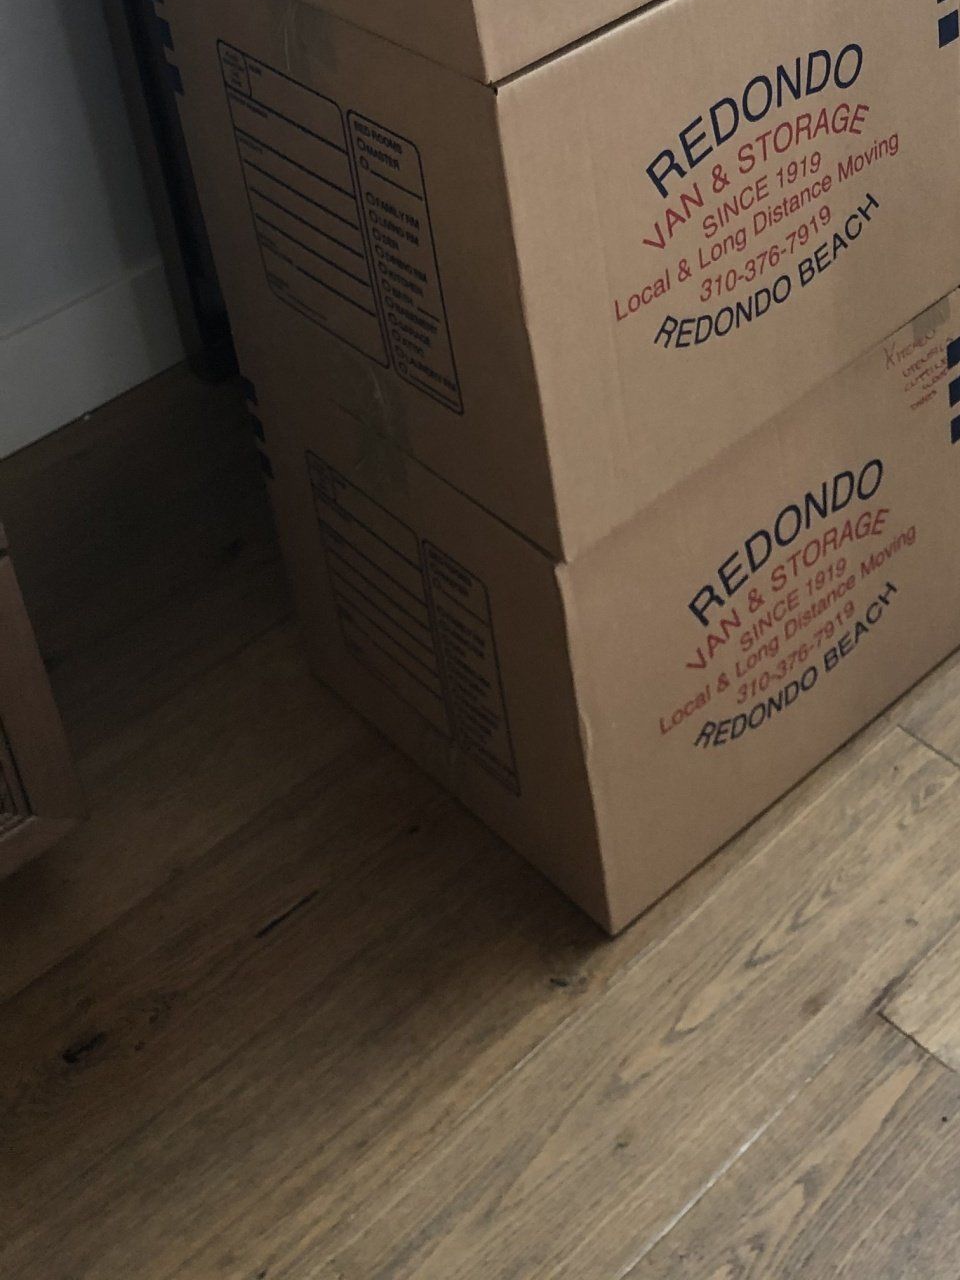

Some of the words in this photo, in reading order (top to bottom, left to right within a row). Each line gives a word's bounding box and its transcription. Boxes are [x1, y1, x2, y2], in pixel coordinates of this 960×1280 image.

[642, 182, 703, 248] VAN
[712, 164, 730, 193] &
[739, 103, 870, 174] STORAGE
[645, 43, 862, 198] REDONDO
[703, 175, 768, 238] SINCE
[777, 152, 820, 187] 1919
[615, 269, 670, 321] Local
[678, 259, 692, 282] &
[699, 228, 746, 269] Long
[754, 175, 831, 235] Distance
[838, 132, 898, 182] Moving
[654, 274, 791, 348] REDONDO
[799, 192, 879, 286] BEACH
[700, 206, 830, 302] 310-376-7919
[685, 607, 739, 668] VAN
[747, 587, 764, 612] &
[771, 509, 889, 591] STORAGE
[688, 459, 883, 626] REDONDO
[739, 588, 798, 650] SINCE
[805, 558, 844, 595] 1919
[661, 684, 710, 736] Local
[717, 672, 730, 692] &
[735, 635, 778, 678] Long
[784, 575, 854, 639] Distance
[860, 526, 915, 579] Moving
[696, 665, 818, 748] REDONDO
[824, 582, 897, 672] BEACH
[737, 601, 853, 703] 310-376-7919
